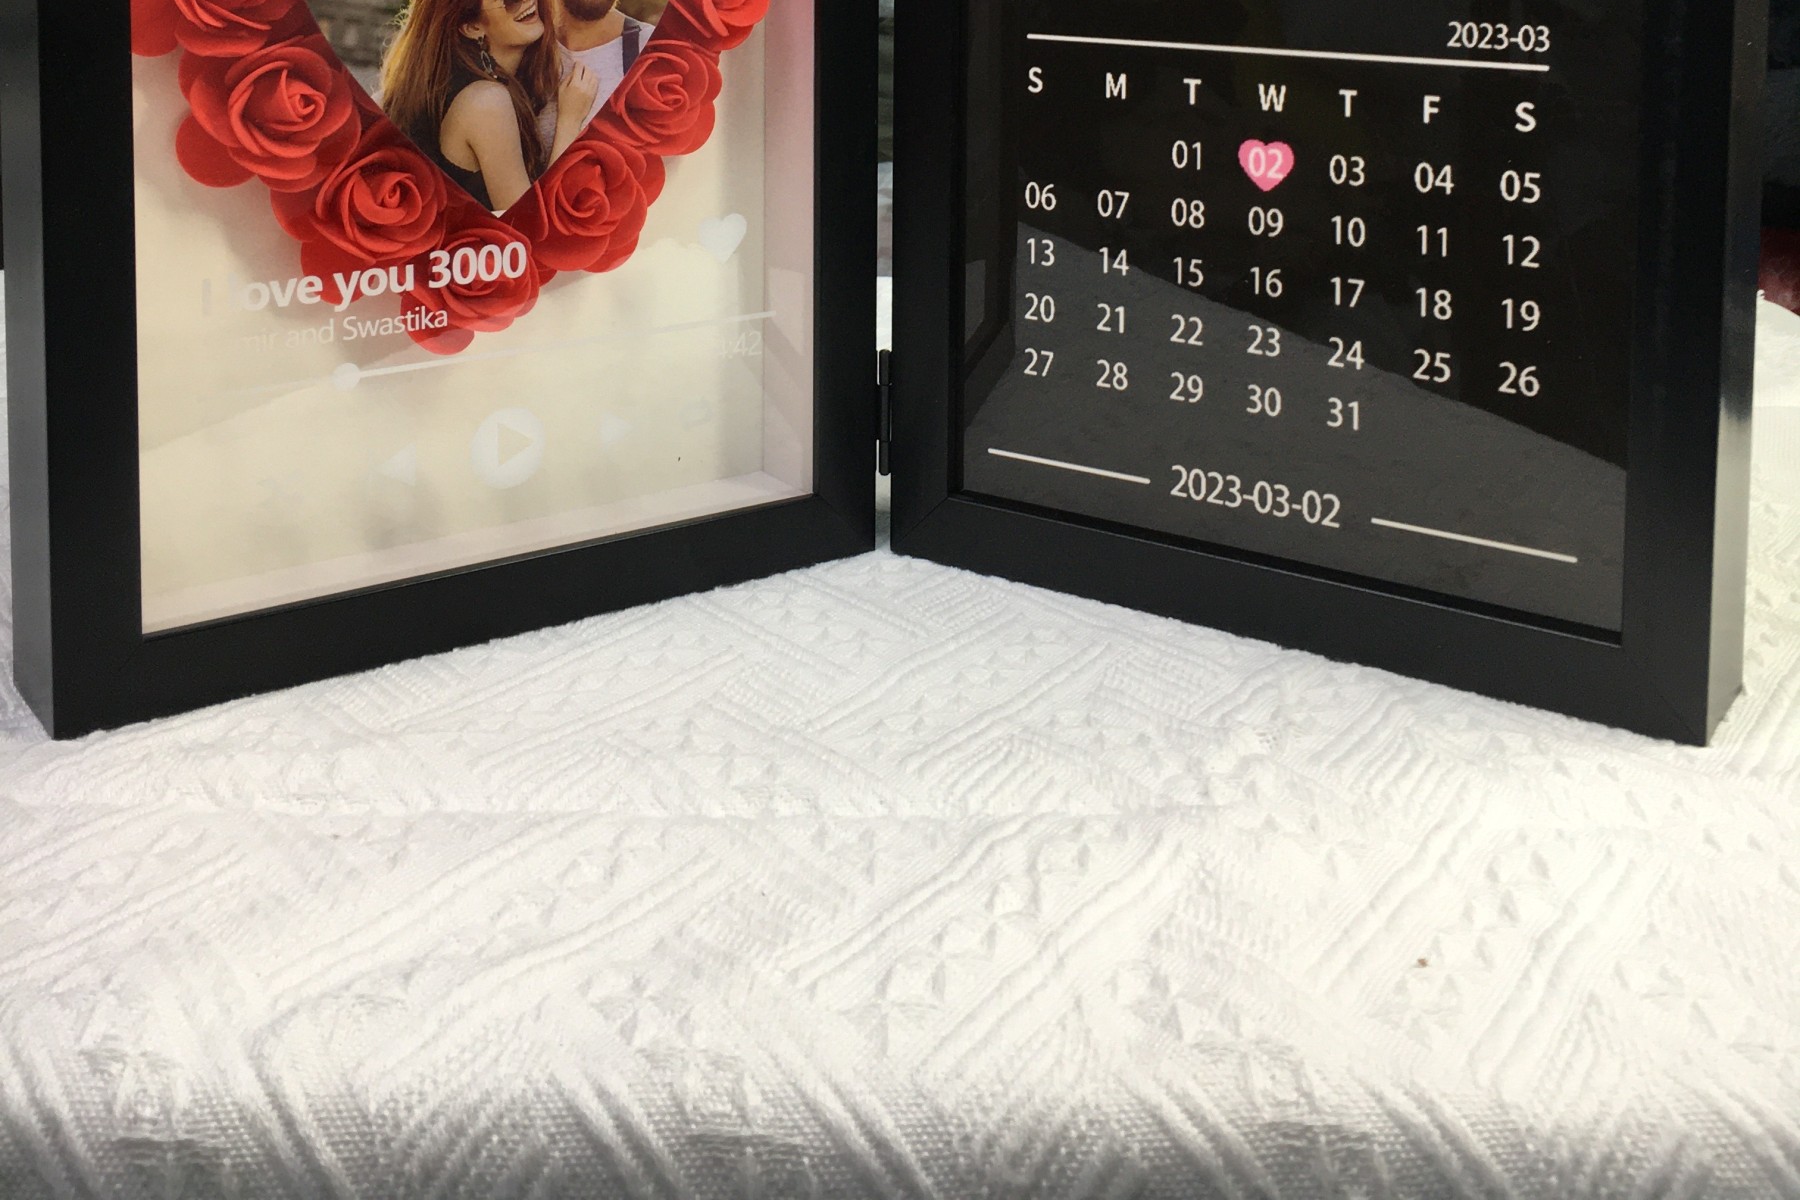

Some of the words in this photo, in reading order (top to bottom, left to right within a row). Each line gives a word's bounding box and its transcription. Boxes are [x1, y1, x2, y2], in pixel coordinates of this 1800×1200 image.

[1447, 21, 1551, 53] 2023-03
[1027, 66, 1043, 93] S
[1105, 72, 1127, 100] M
[1183, 78, 1202, 105] T
[1258, 83, 1287, 112] W
[1338, 89, 1358, 118] T
[1423, 95, 1441, 124] F
[1515, 101, 1537, 133] S
[1172, 140, 1203, 170] 01
[1247, 147, 1284, 181] 02
[1329, 154, 1366, 187] 03
[1414, 162, 1455, 195] 04
[1499, 170, 1541, 204] 05
[1024, 181, 1057, 211] 06
[1097, 189, 1130, 219] 07
[1171, 197, 1205, 229] 08
[1248, 206, 1284, 237] 09
[1331, 215, 1366, 248] 10
[1417, 224, 1449, 257] 11
[1502, 234, 1540, 268] 12
[333, 263, 415, 313] you
[427, 241, 528, 290] 3000
[1026, 237, 1055, 267] 13
[1099, 247, 1130, 276] 14
[1173, 257, 1204, 287] 15
[1250, 266, 1283, 298] 16
[1330, 276, 1365, 308] 17
[1416, 287, 1452, 320] 18
[1501, 298, 1540, 332] 19
[285, 317, 335, 349] and
[342, 305, 449, 342] Swastika
[1024, 292, 1056, 323] 20
[1096, 303, 1126, 334] 21
[1170, 313, 1204, 346] 22
[1246, 324, 1281, 357] 23
[1327, 336, 1365, 371] 24
[1413, 348, 1451, 383] 25
[1498, 361, 1540, 397] 26
[1023, 347, 1054, 377] 27
[1096, 359, 1129, 391] 28
[1169, 371, 1204, 403] 29
[1246, 384, 1282, 417] 30
[1326, 397, 1361, 431] 31
[1170, 464, 1341, 529] 2023-03-02
